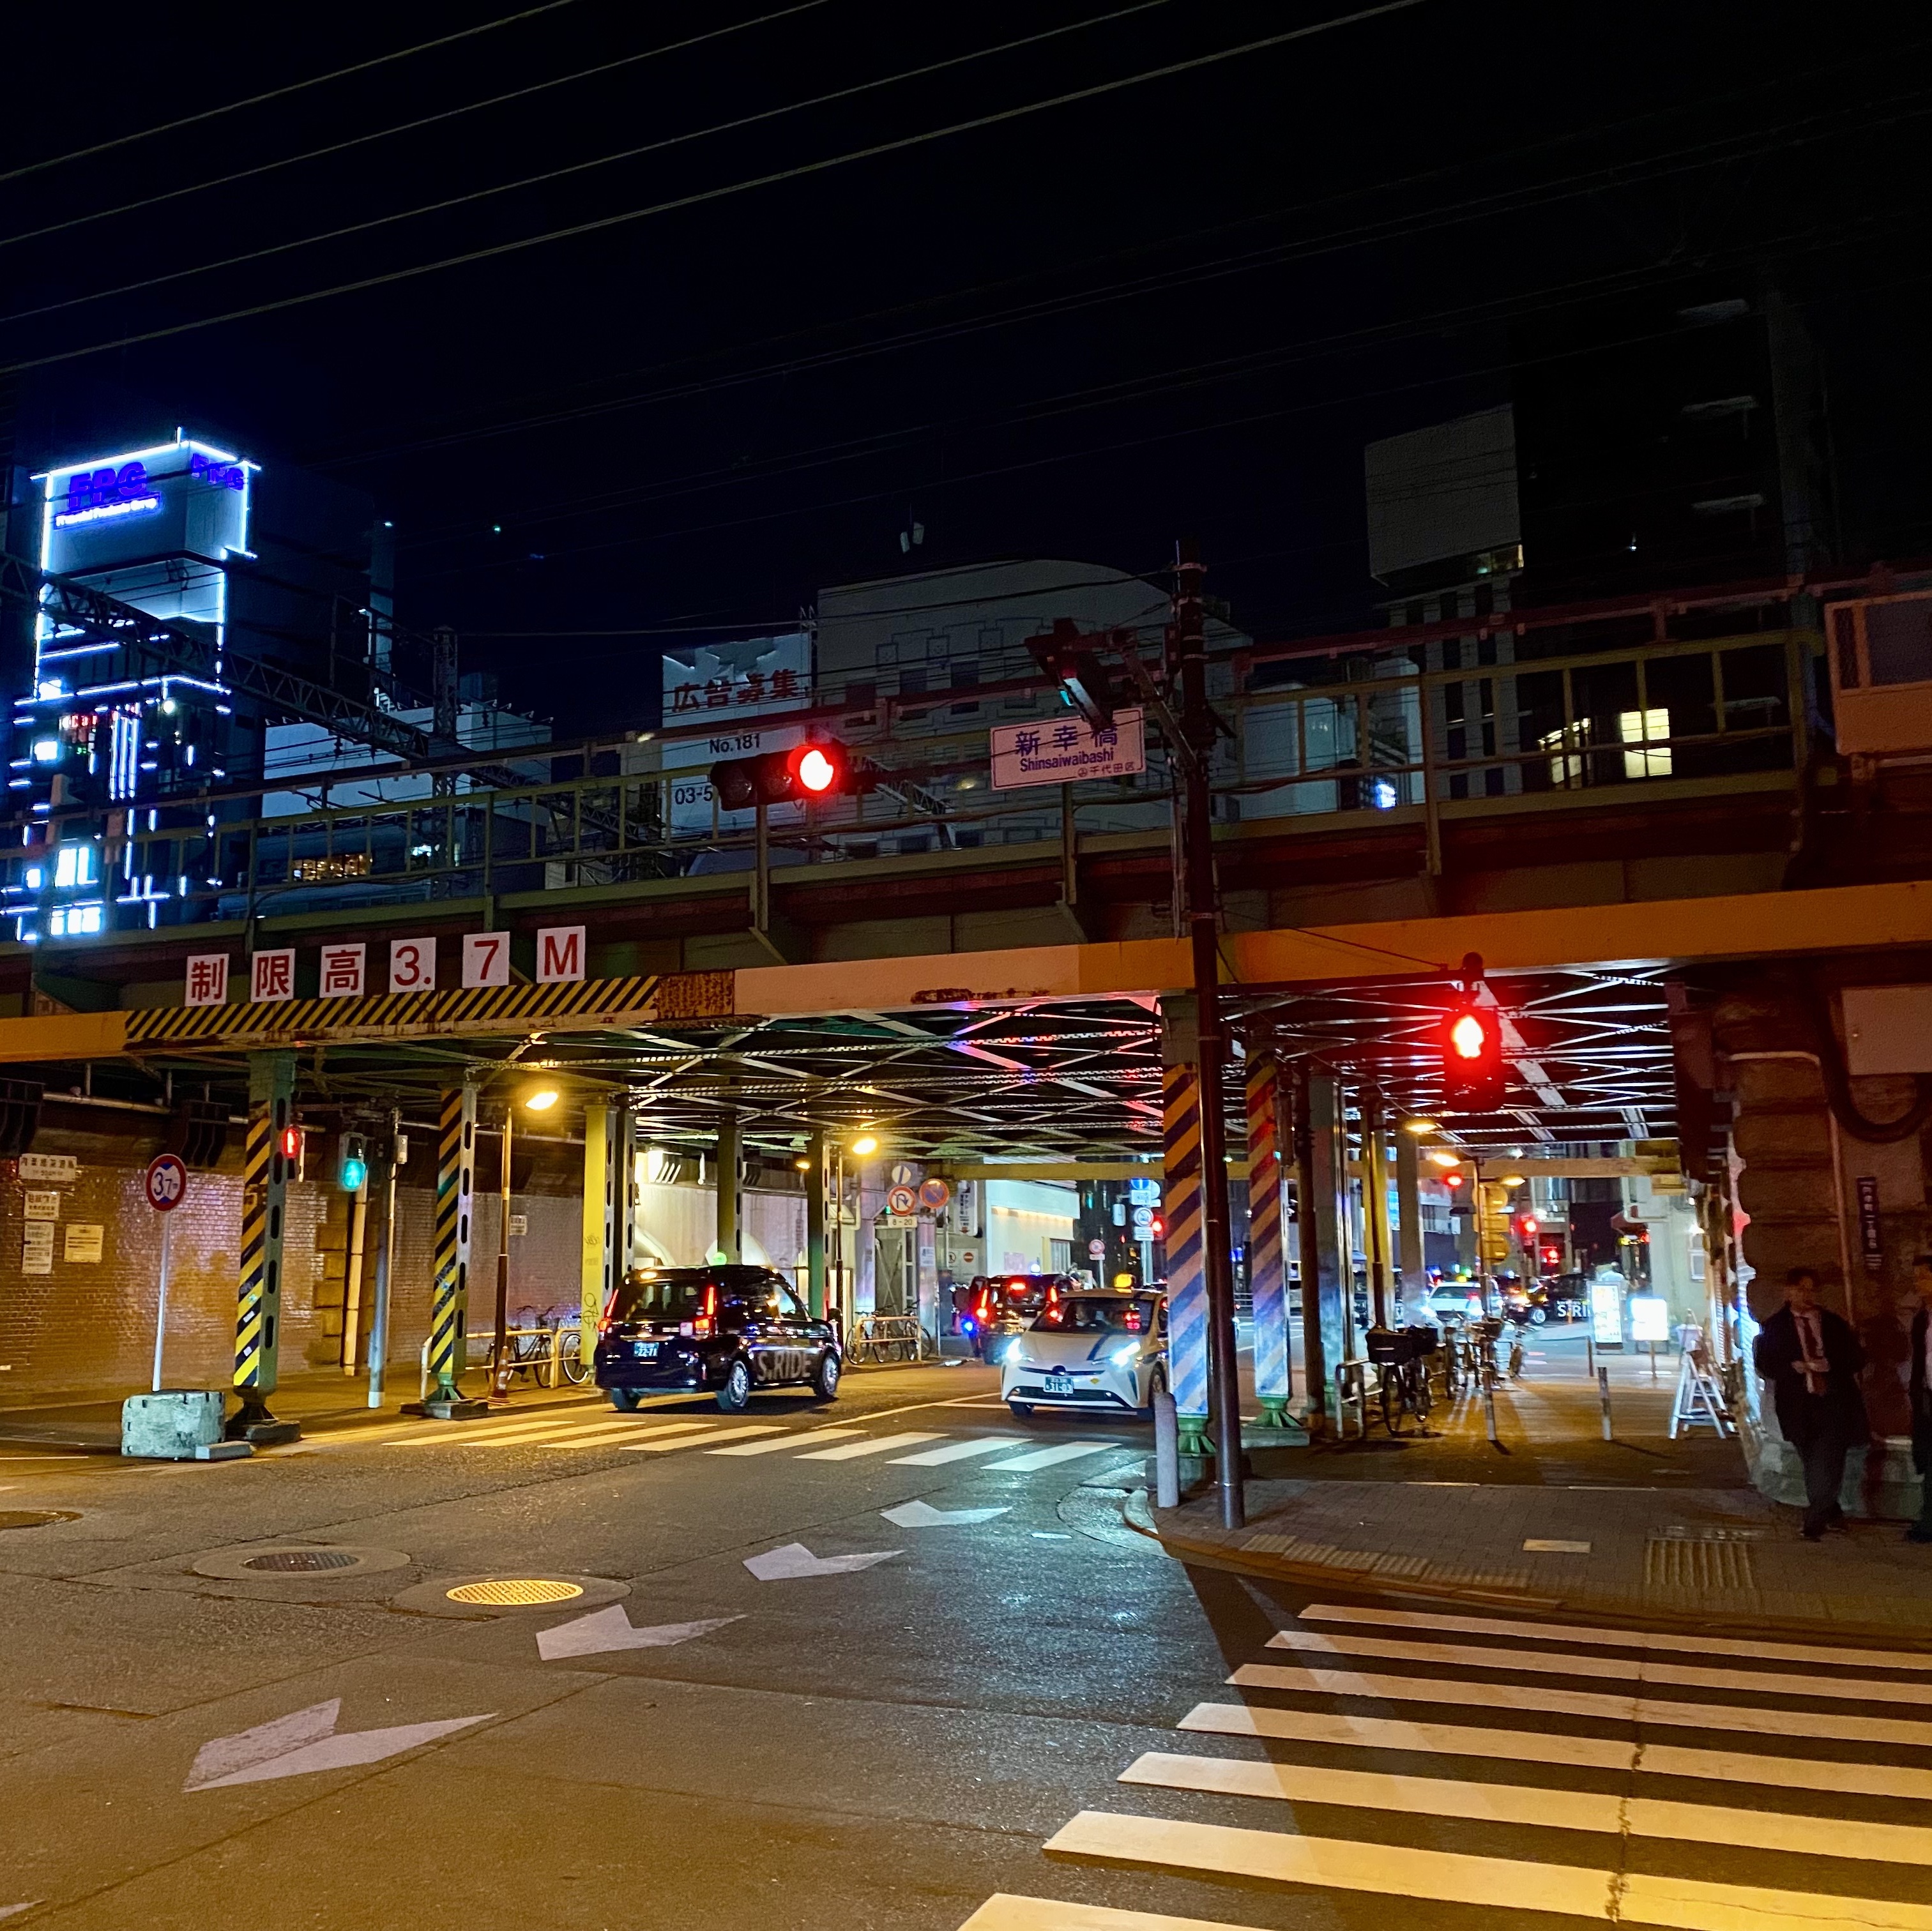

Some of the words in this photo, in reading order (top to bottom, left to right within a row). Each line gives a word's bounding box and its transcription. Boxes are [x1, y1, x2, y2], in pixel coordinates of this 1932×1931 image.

[69, 462, 147, 508] FPG
[710, 734, 760, 754] No.181
[1015, 722, 1118, 757] 新幸橋
[1020, 747, 1114, 772] Shinsaiwaibashi
[756, 1350, 812, 1381] S.RIDE
